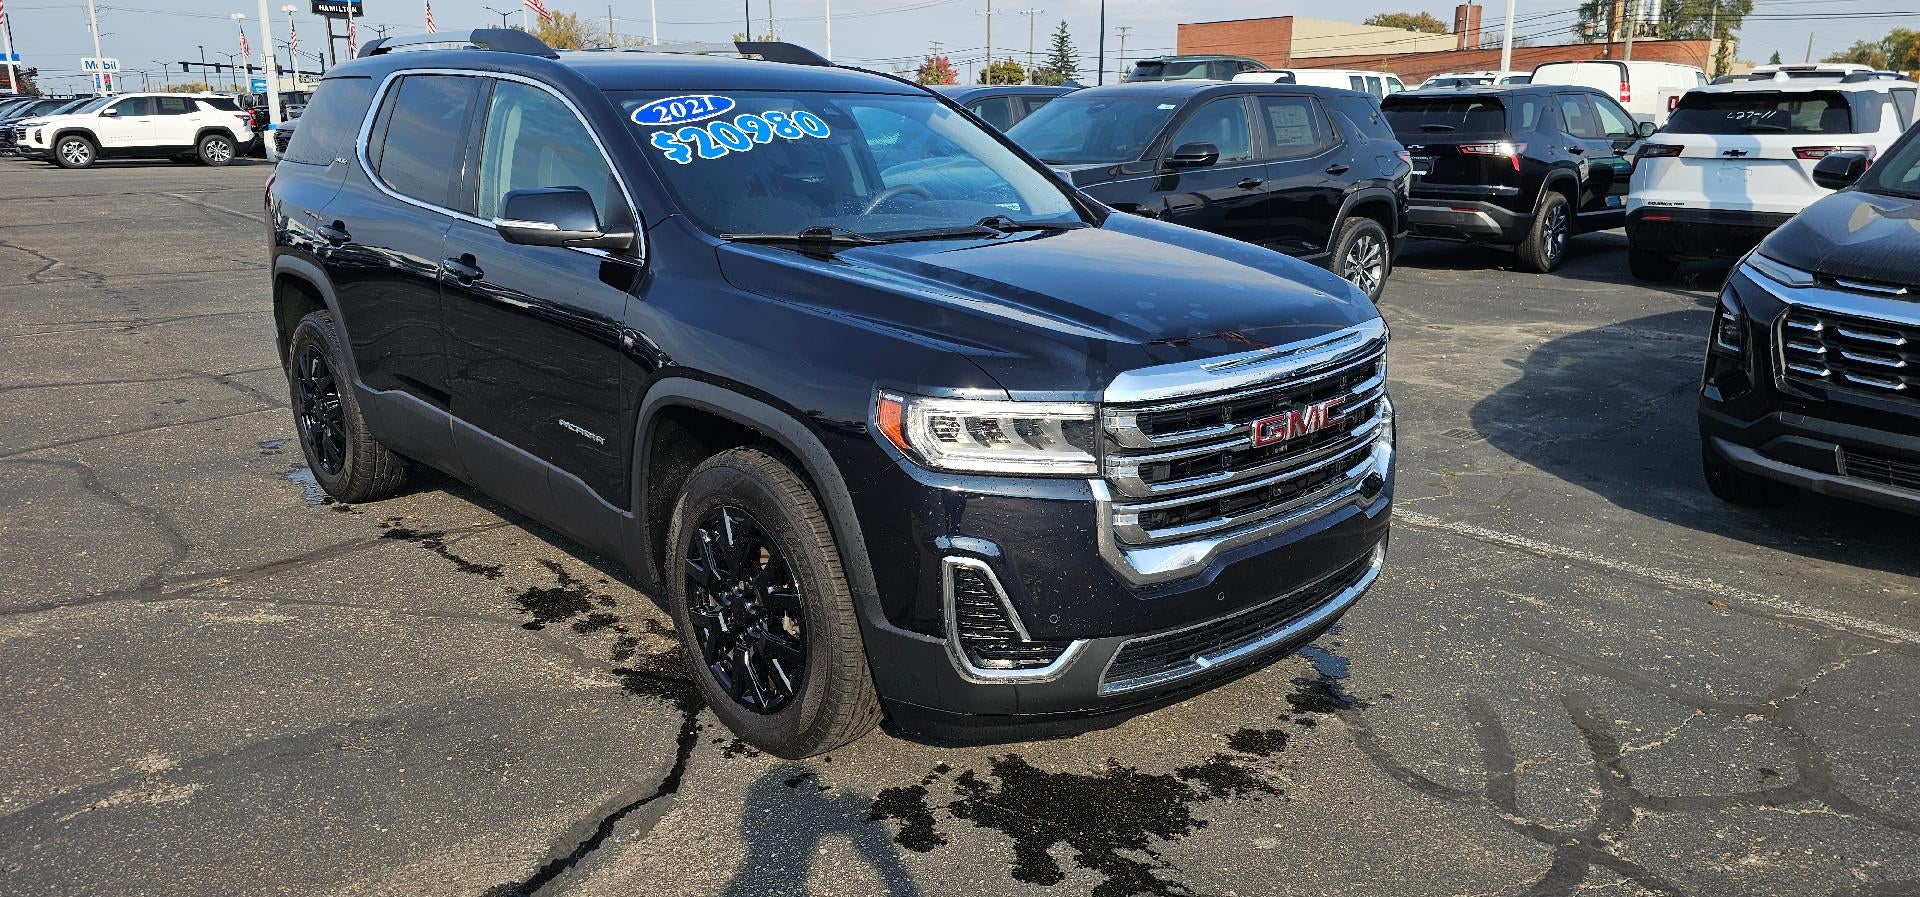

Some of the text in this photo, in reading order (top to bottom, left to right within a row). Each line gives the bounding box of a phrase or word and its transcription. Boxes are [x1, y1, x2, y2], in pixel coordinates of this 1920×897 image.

[318, 4, 358, 13] HAMILTN
[652, 96, 718, 123] 2021
[650, 110, 831, 165] $20980
[1251, 396, 1346, 448] GMC
